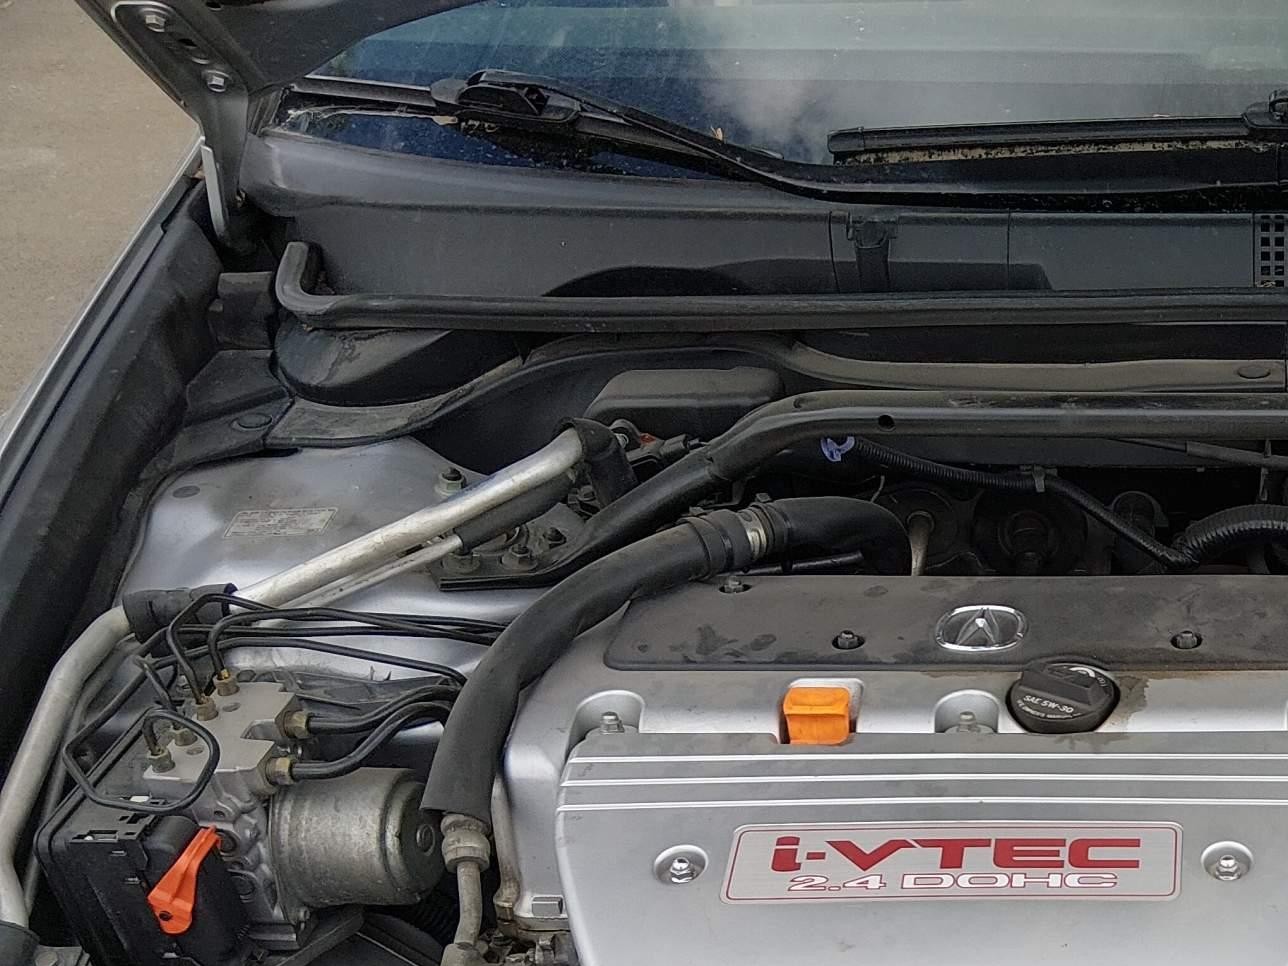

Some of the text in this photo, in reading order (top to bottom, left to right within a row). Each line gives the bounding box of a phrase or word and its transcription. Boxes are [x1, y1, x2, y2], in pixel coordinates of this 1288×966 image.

[1023, 695, 1041, 704] SAE
[1040, 700, 1074, 713] 5W-30
[771, 836, 1141, 872] i-VTEC
[787, 871, 1119, 892] 2.4 DOHC
